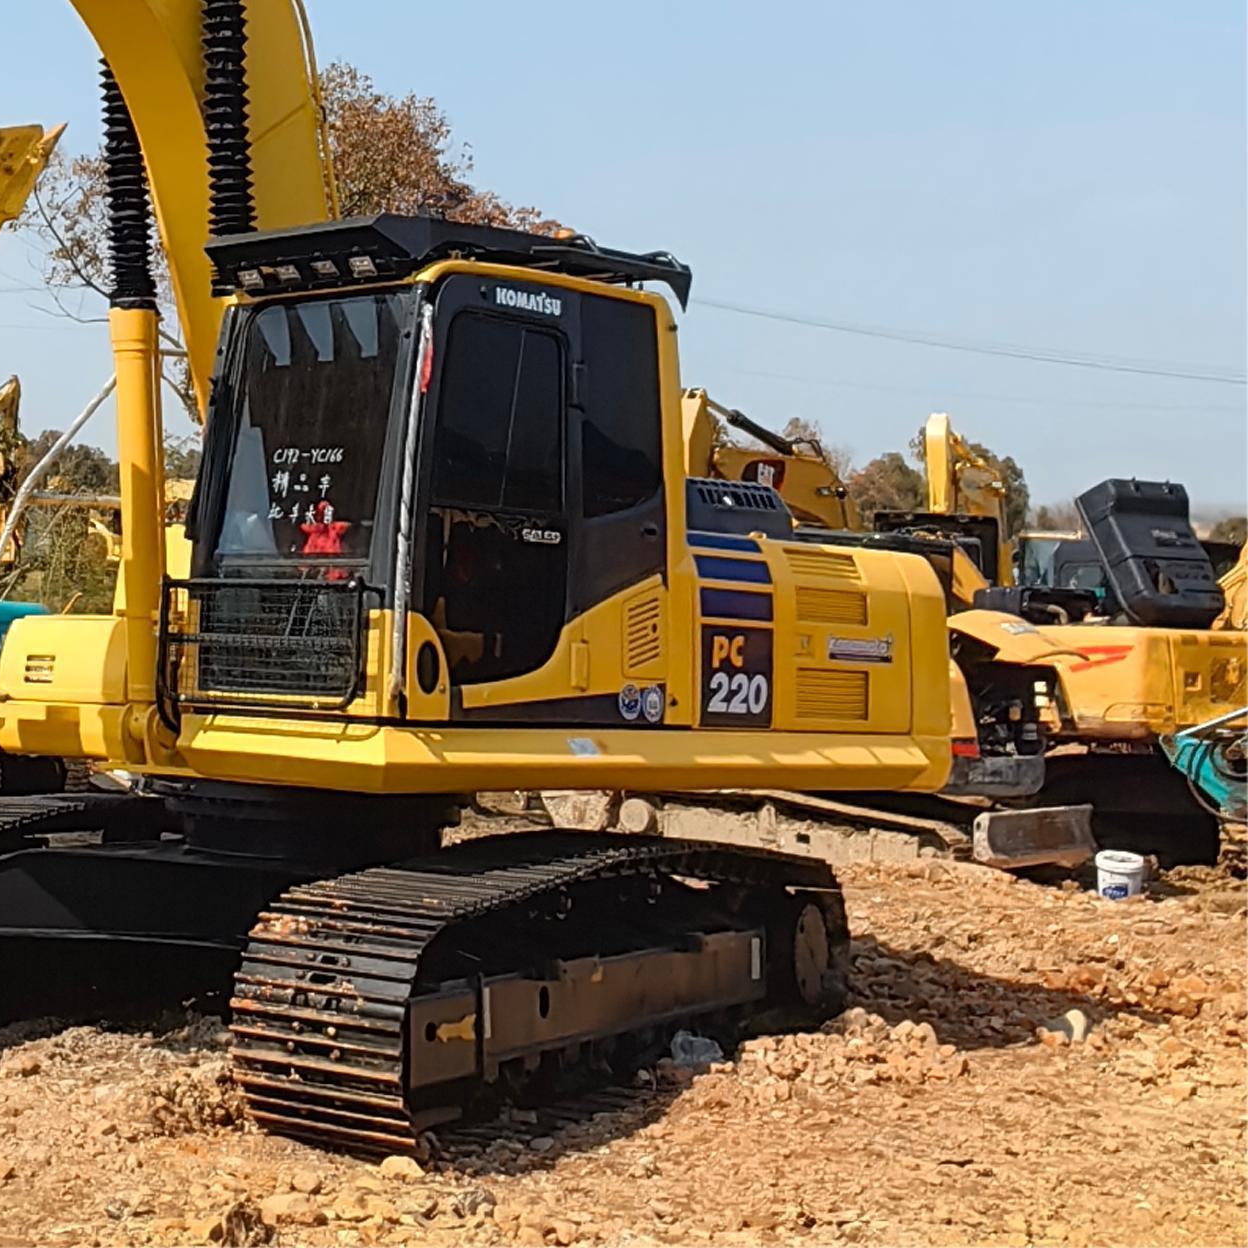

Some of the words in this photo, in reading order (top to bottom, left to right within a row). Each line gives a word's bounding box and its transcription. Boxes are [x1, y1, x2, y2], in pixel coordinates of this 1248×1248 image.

[496, 287, 561, 316] KOMATSU
[712, 635, 745, 668] PC
[707, 672, 768, 714] 220
